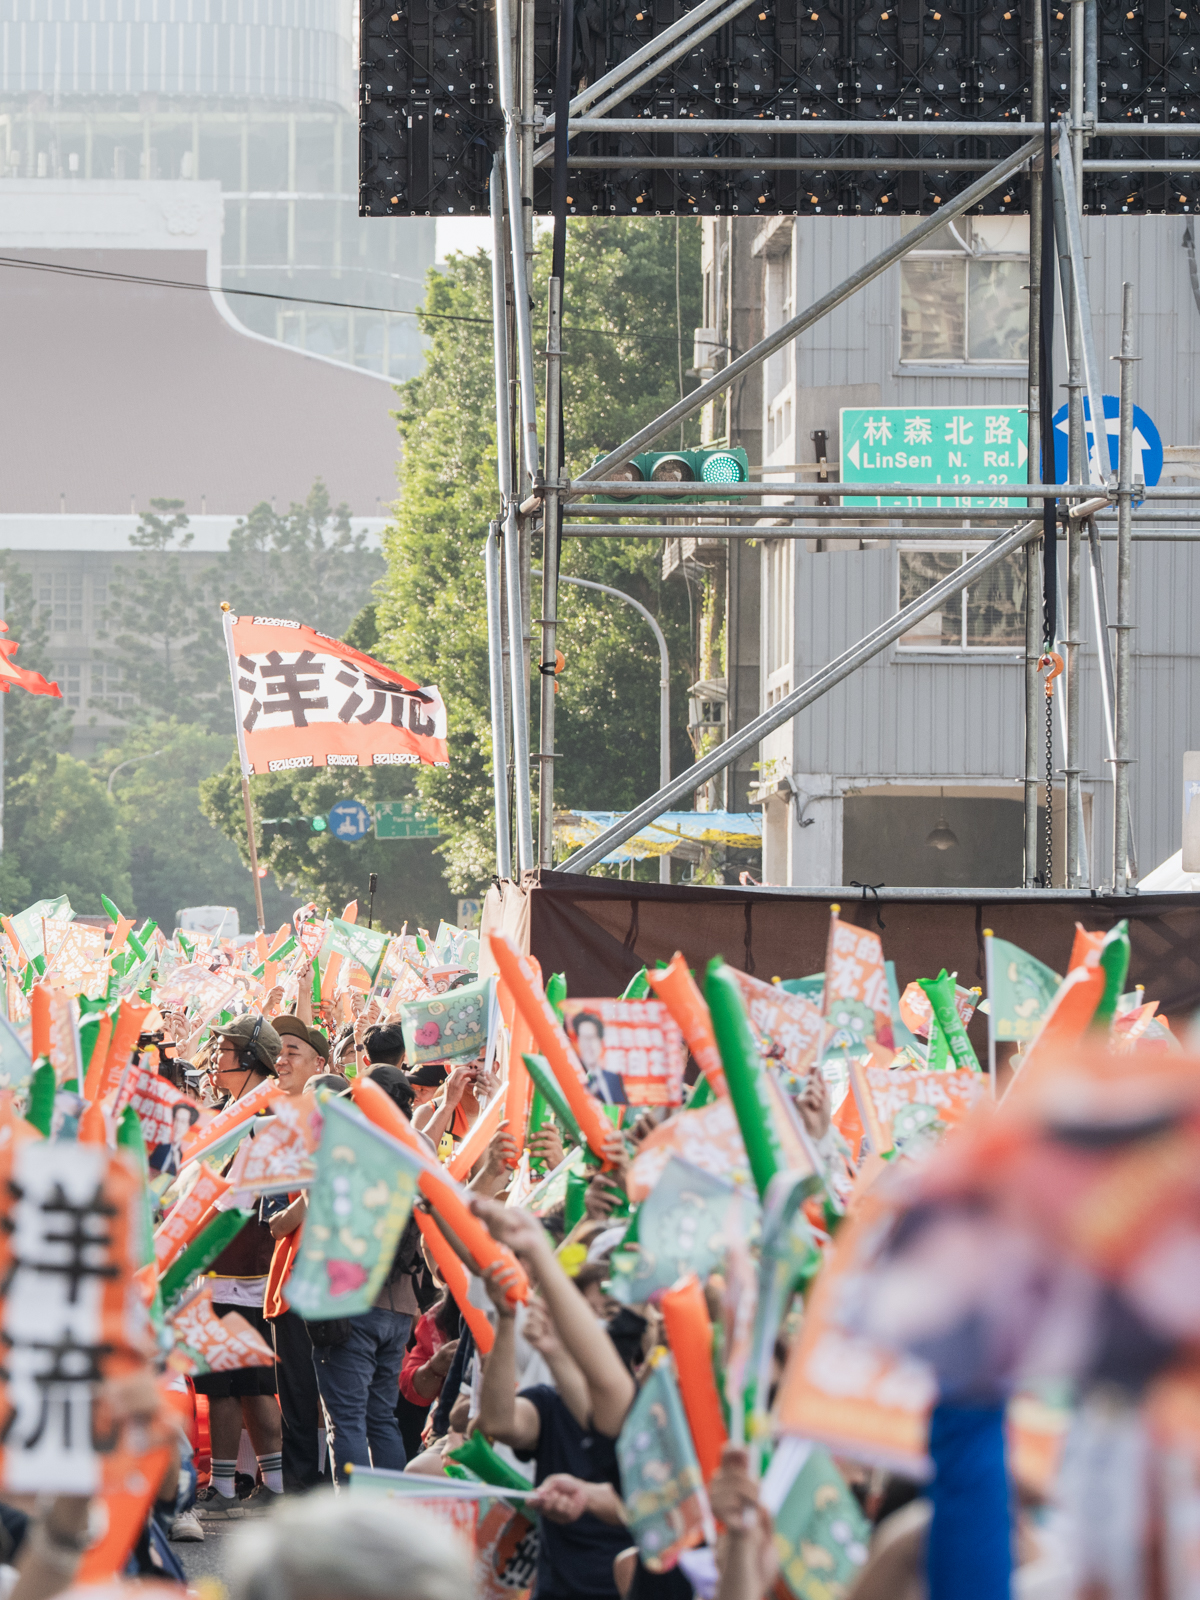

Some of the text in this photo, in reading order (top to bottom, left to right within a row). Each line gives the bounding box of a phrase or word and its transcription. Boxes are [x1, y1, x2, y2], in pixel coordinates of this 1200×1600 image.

[863, 415, 1014, 446] 林森北路
[863, 451, 1015, 468] LinSen N. Rd.
[253, 616, 301, 629] 20261128
[238, 650, 436, 737] 洋流
[0, 1176, 123, 1456] 洋流
